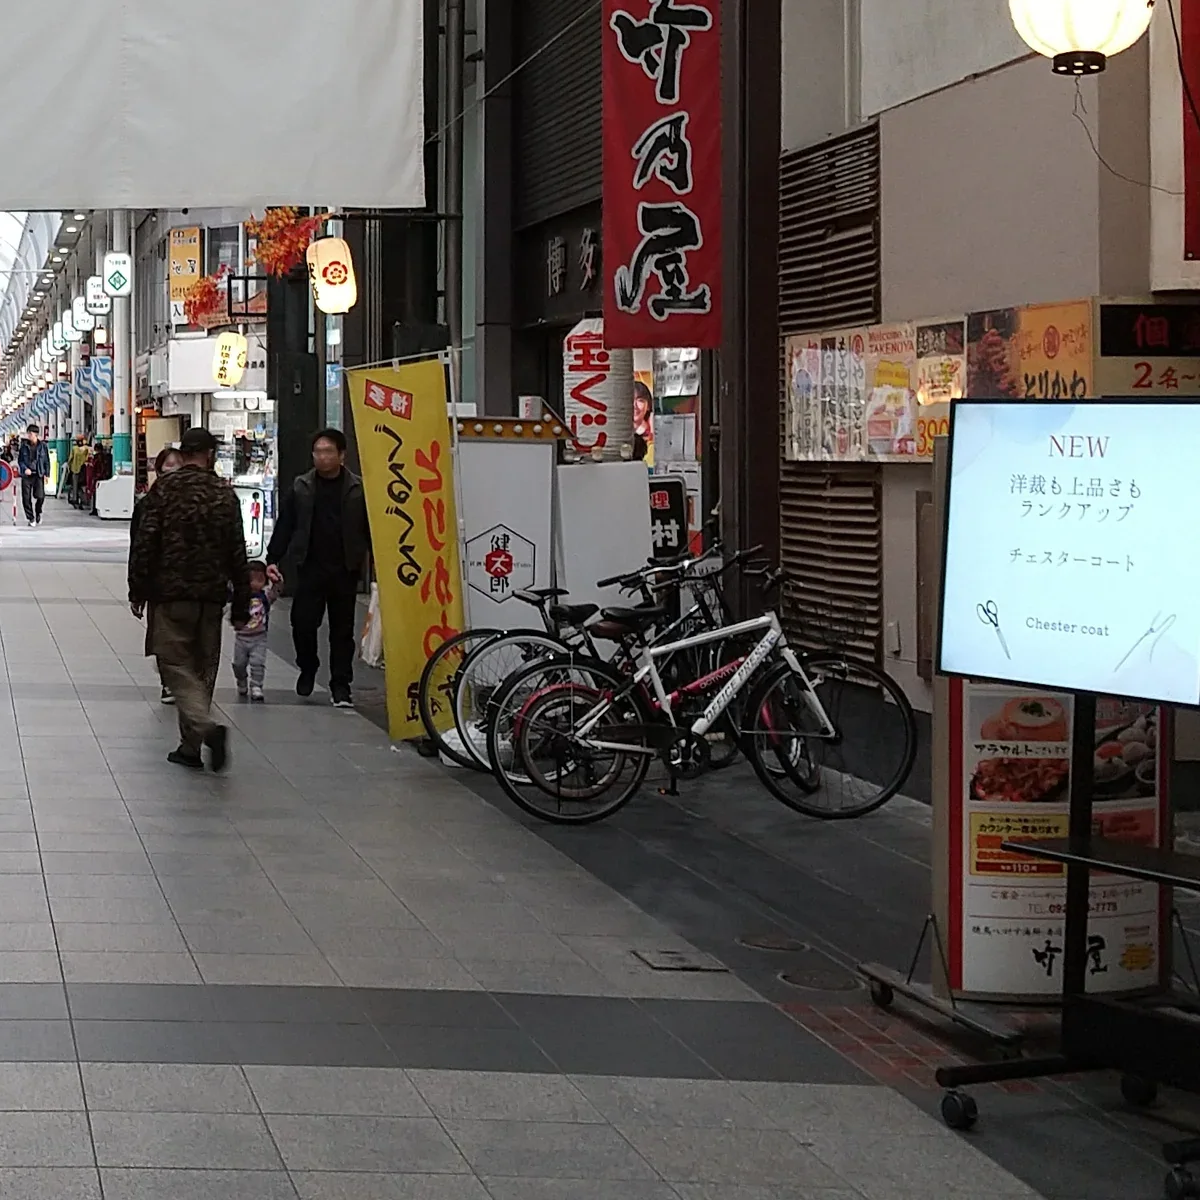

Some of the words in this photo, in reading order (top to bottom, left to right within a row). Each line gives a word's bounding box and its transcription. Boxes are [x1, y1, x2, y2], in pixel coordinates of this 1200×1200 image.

[1049, 435, 1111, 459] NEW
[1010, 473, 1142, 499] 洋裁も上品さも
[1021, 500, 1134, 522] ランクアップ
[1009, 547, 1134, 572] チェスターコート
[1026, 617, 1077, 634] Chester
[1081, 623, 1109, 637] coat
[1032, 935, 1108, 977] 竹屋
